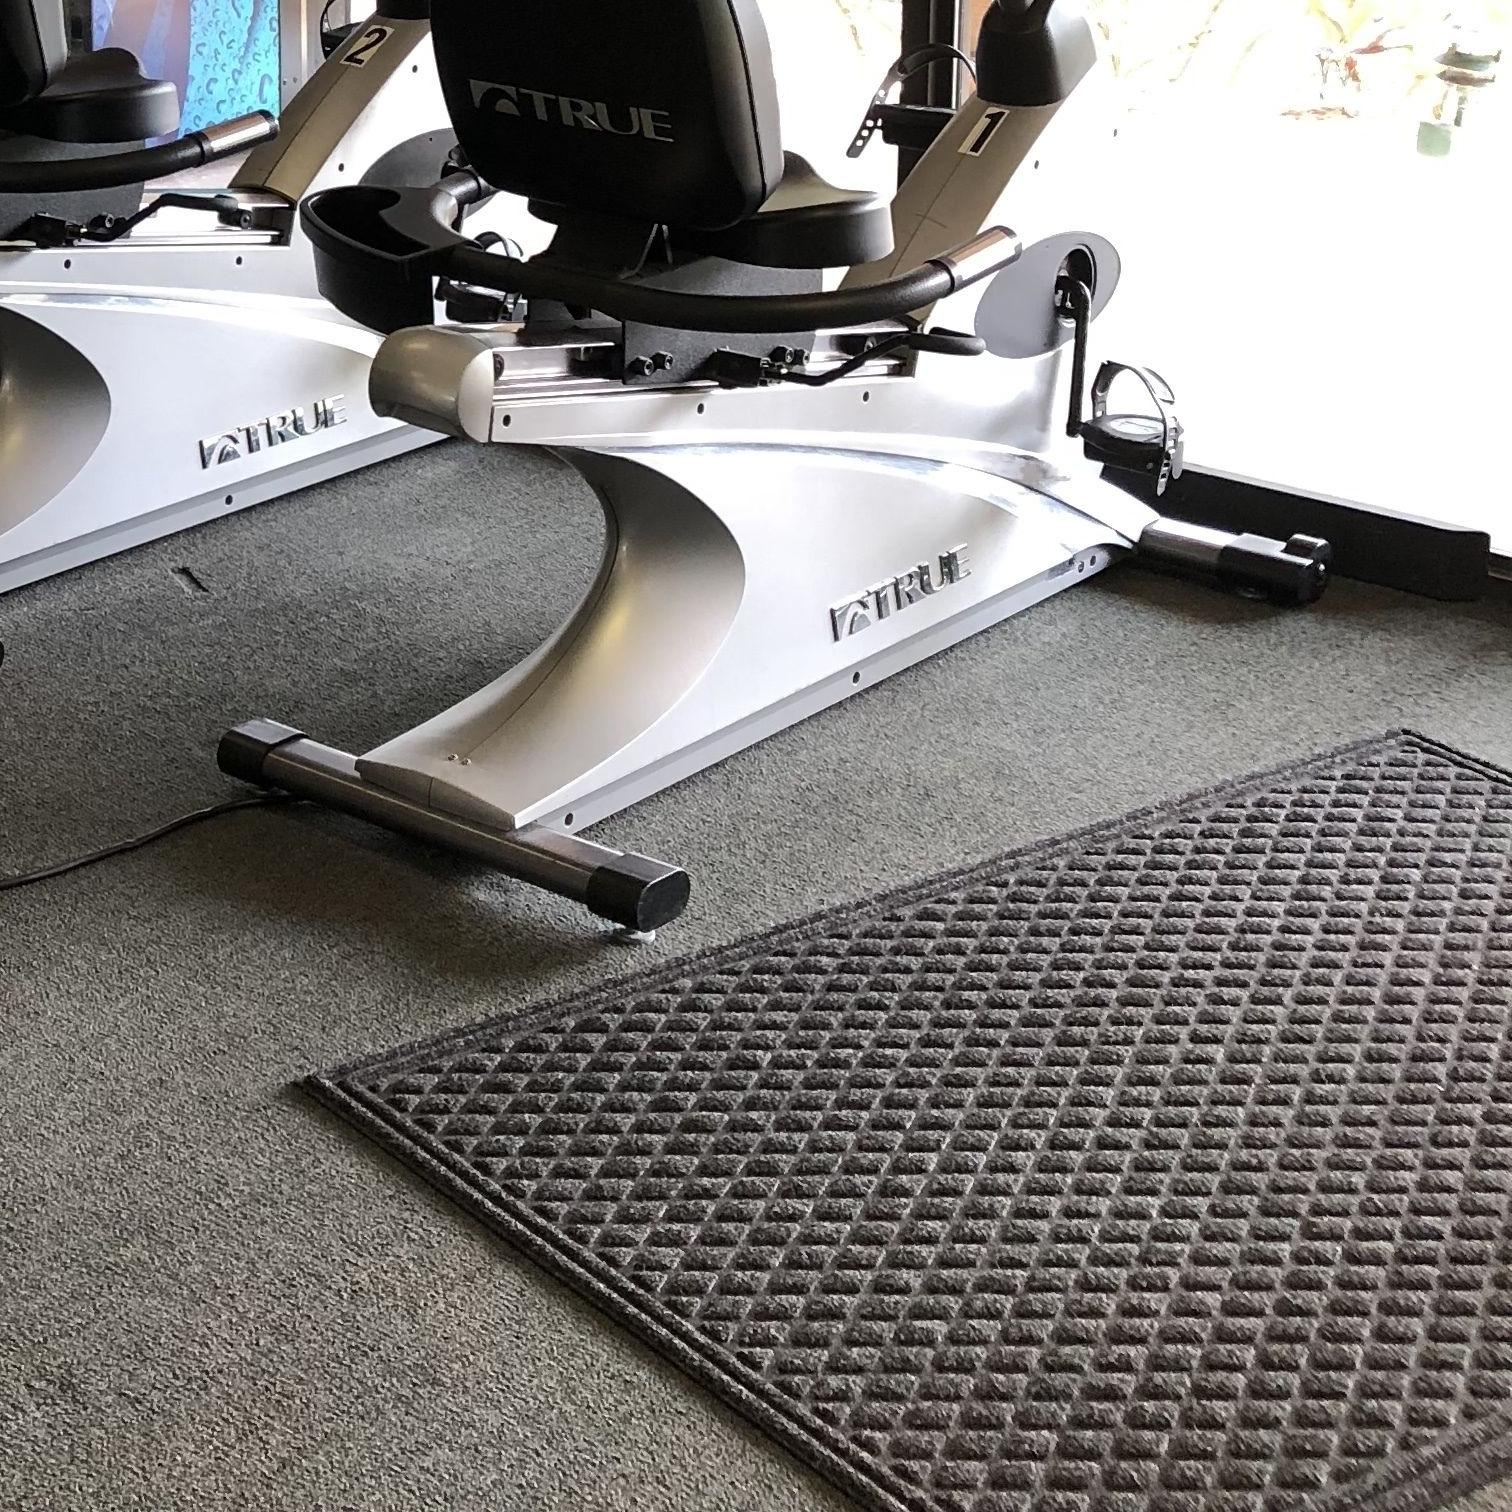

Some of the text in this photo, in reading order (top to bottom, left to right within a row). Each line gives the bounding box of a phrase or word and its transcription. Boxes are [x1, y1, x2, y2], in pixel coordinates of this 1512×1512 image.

[344, 28, 387, 66] 2
[519, 88, 675, 142] TRUE
[968, 110, 1007, 154] 1
[237, 393, 348, 455] TRUE
[868, 541, 972, 621] TRUE
